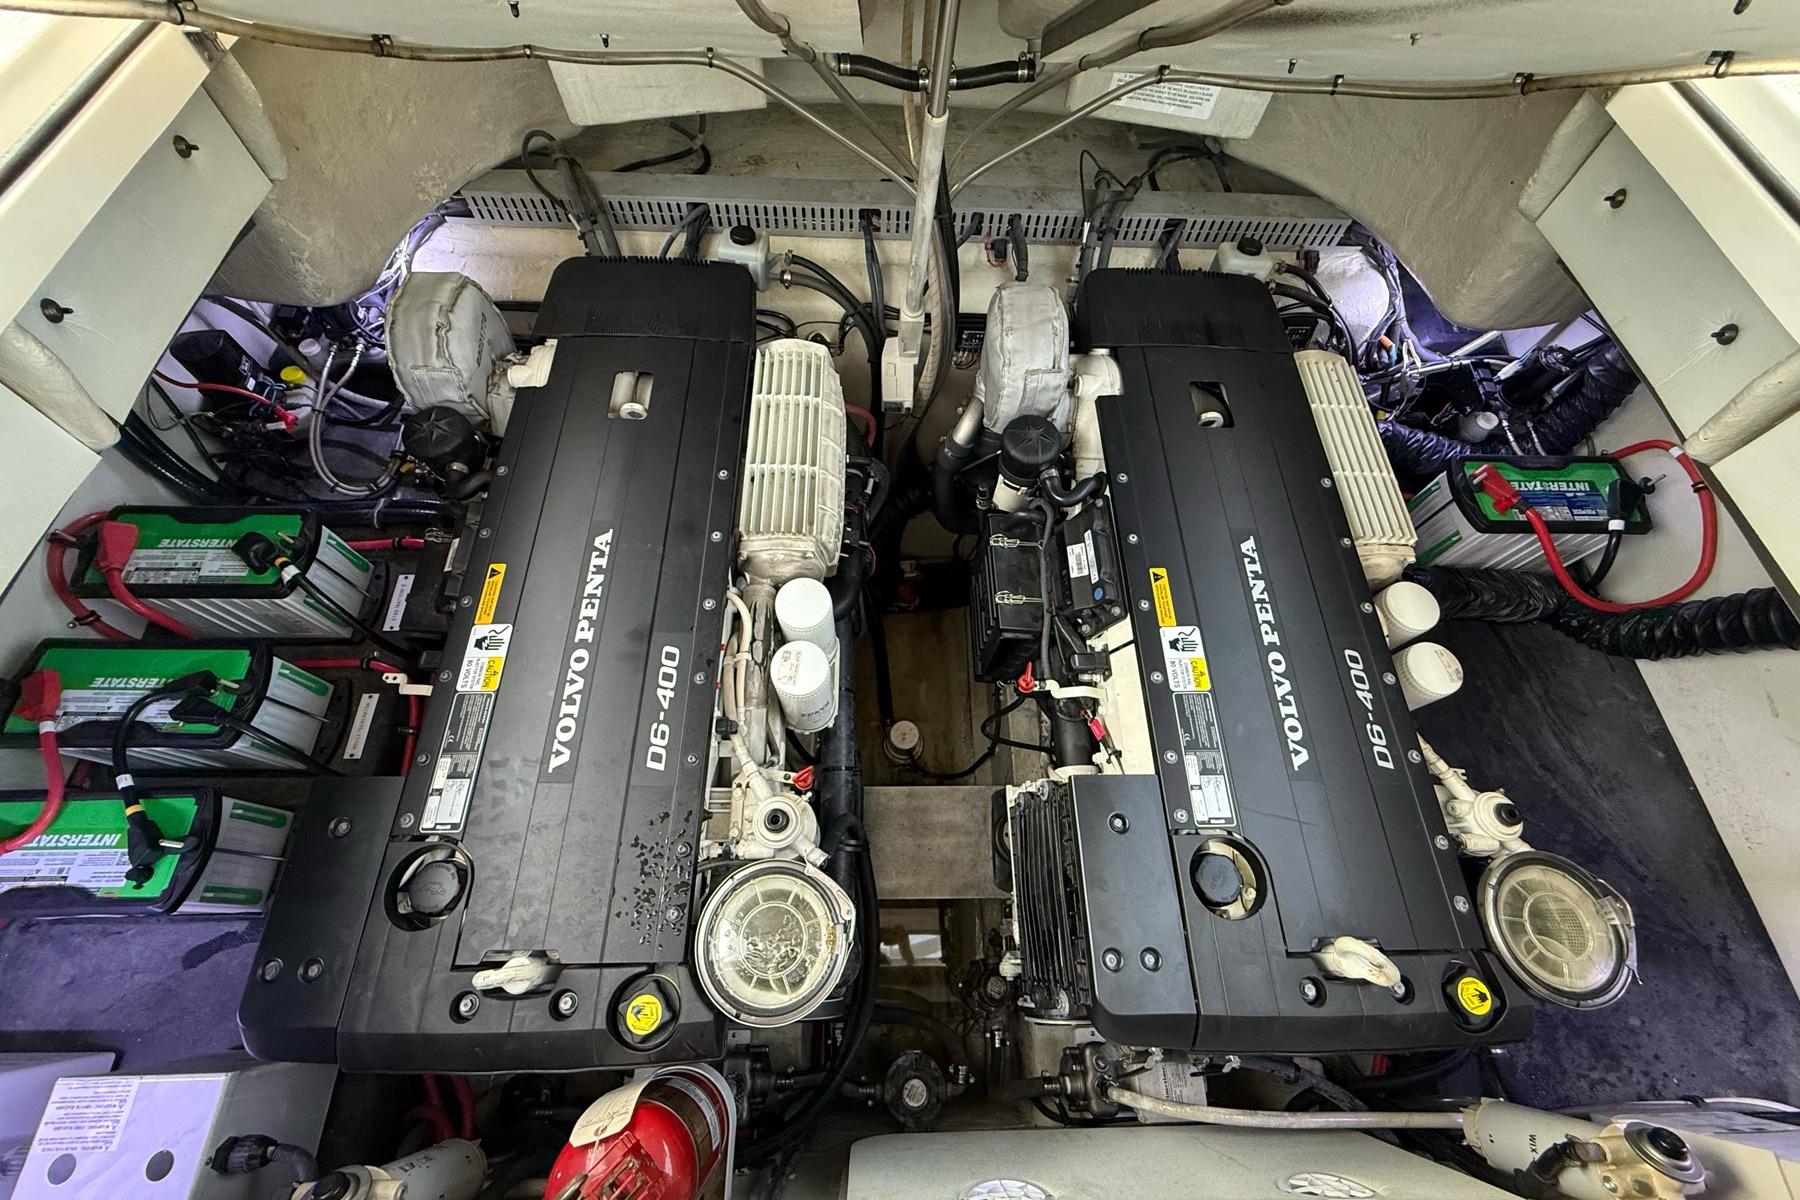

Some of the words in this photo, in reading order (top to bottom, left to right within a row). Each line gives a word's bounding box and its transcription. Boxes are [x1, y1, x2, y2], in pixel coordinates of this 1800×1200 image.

[158, 538, 238, 548] NTERSTATE
[1239, 535, 1281, 647] PENTA
[466, 659, 474, 667] 80
[548, 647, 590, 774] VOLVO
[574, 528, 614, 643] PENTA
[460, 668, 471, 689] VOLTS
[482, 659, 496, 688] CAUTION
[1171, 668, 1181, 689] VOLTS
[1190, 660, 1203, 688] CAUTION
[646, 645, 680, 772] D6-400
[1267, 651, 1310, 772] VOLVO
[1344, 648, 1395, 770] D6-400
[22, 833, 122, 848] INTERSTAT
[1529, 1134, 1539, 1155] WIX
